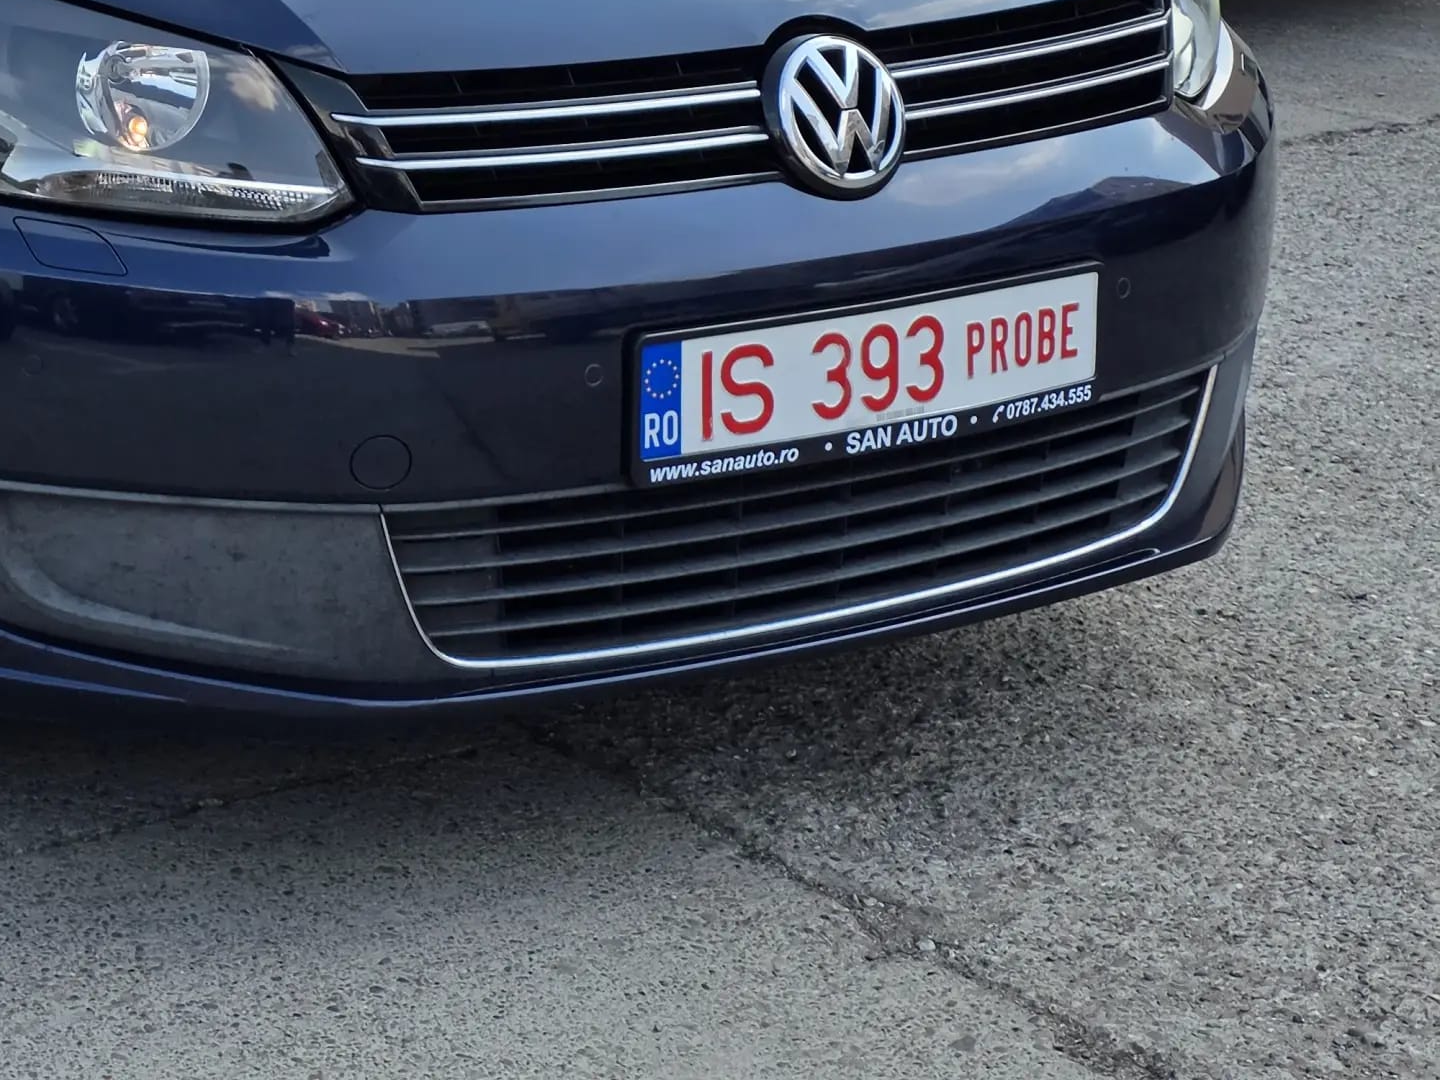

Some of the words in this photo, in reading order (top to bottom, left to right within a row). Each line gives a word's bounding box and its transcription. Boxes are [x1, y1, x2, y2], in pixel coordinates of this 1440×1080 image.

[701, 343, 775, 441] IS
[811, 314, 945, 421] 393
[966, 301, 1080, 380] PROBE
[644, 409, 679, 449] RO
[649, 447, 800, 483] www.sanauto.ro
[846, 425, 892, 454] SAN
[895, 414, 958, 446] AUTO
[1006, 384, 1093, 420] 0787.434.555
